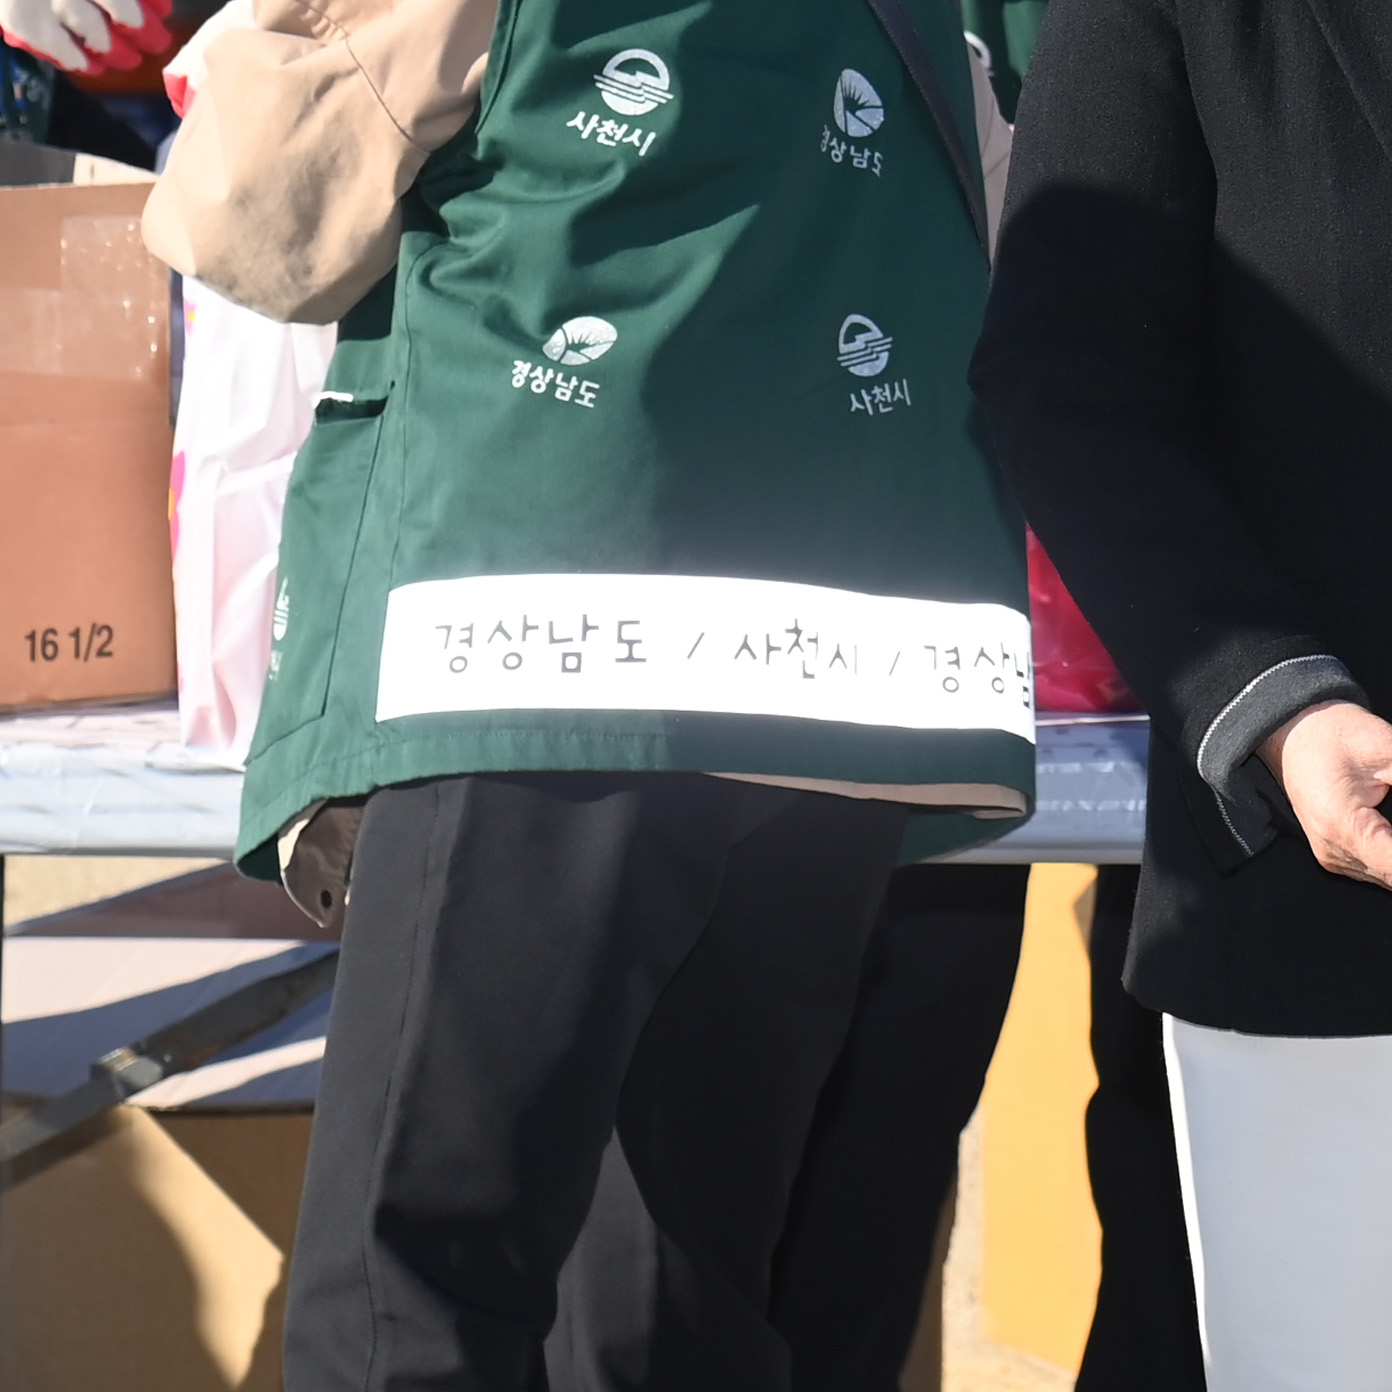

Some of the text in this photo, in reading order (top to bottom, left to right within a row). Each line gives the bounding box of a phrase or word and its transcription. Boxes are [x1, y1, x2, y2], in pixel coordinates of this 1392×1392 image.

[566, 110, 657, 157] 사천시
[820, 123, 884, 178] 경상남도
[511, 359, 601, 408] 경상남도
[850, 379, 912, 416] 사천시
[25, 623, 115, 663] 16 1/2
[435, 613, 647, 674] 경상남도
[734, 618, 858, 680] 사천시
